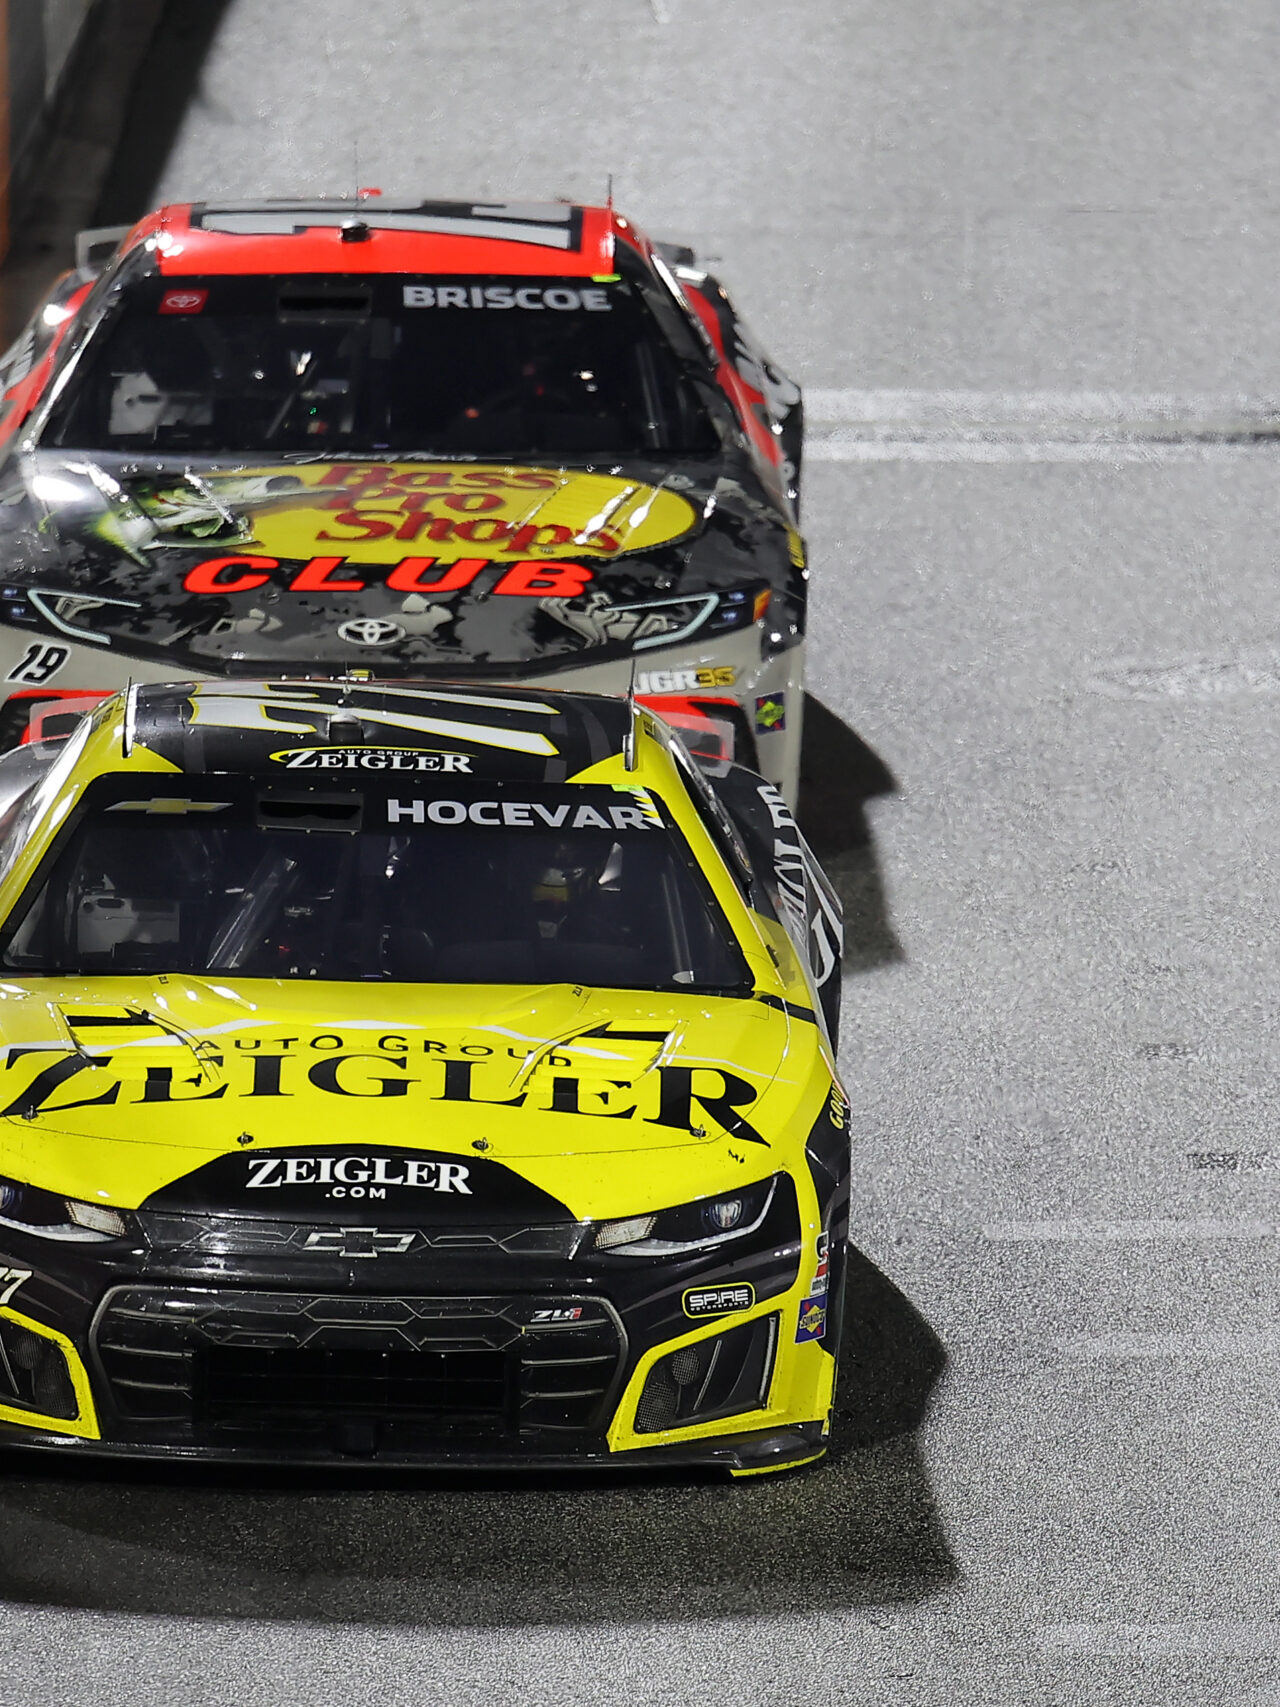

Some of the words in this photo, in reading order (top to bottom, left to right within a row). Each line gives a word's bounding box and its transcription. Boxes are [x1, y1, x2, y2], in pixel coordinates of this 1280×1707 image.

[403, 286, 612, 312] BRISCOE
[315, 465, 560, 489] Bass
[320, 487, 507, 512] Pro
[314, 510, 622, 554] Shops
[184, 556, 594, 598] CLUB
[6, 642, 70, 685] 19
[285, 750, 474, 774] ZEIGLER
[387, 799, 651, 830] HOCEVAR
[198, 1034, 346, 1051] AUTO
[245, 1156, 474, 1195] ZEIGLER
[325, 1186, 387, 1200] .COM
[689, 1288, 749, 1308] SPIRE
